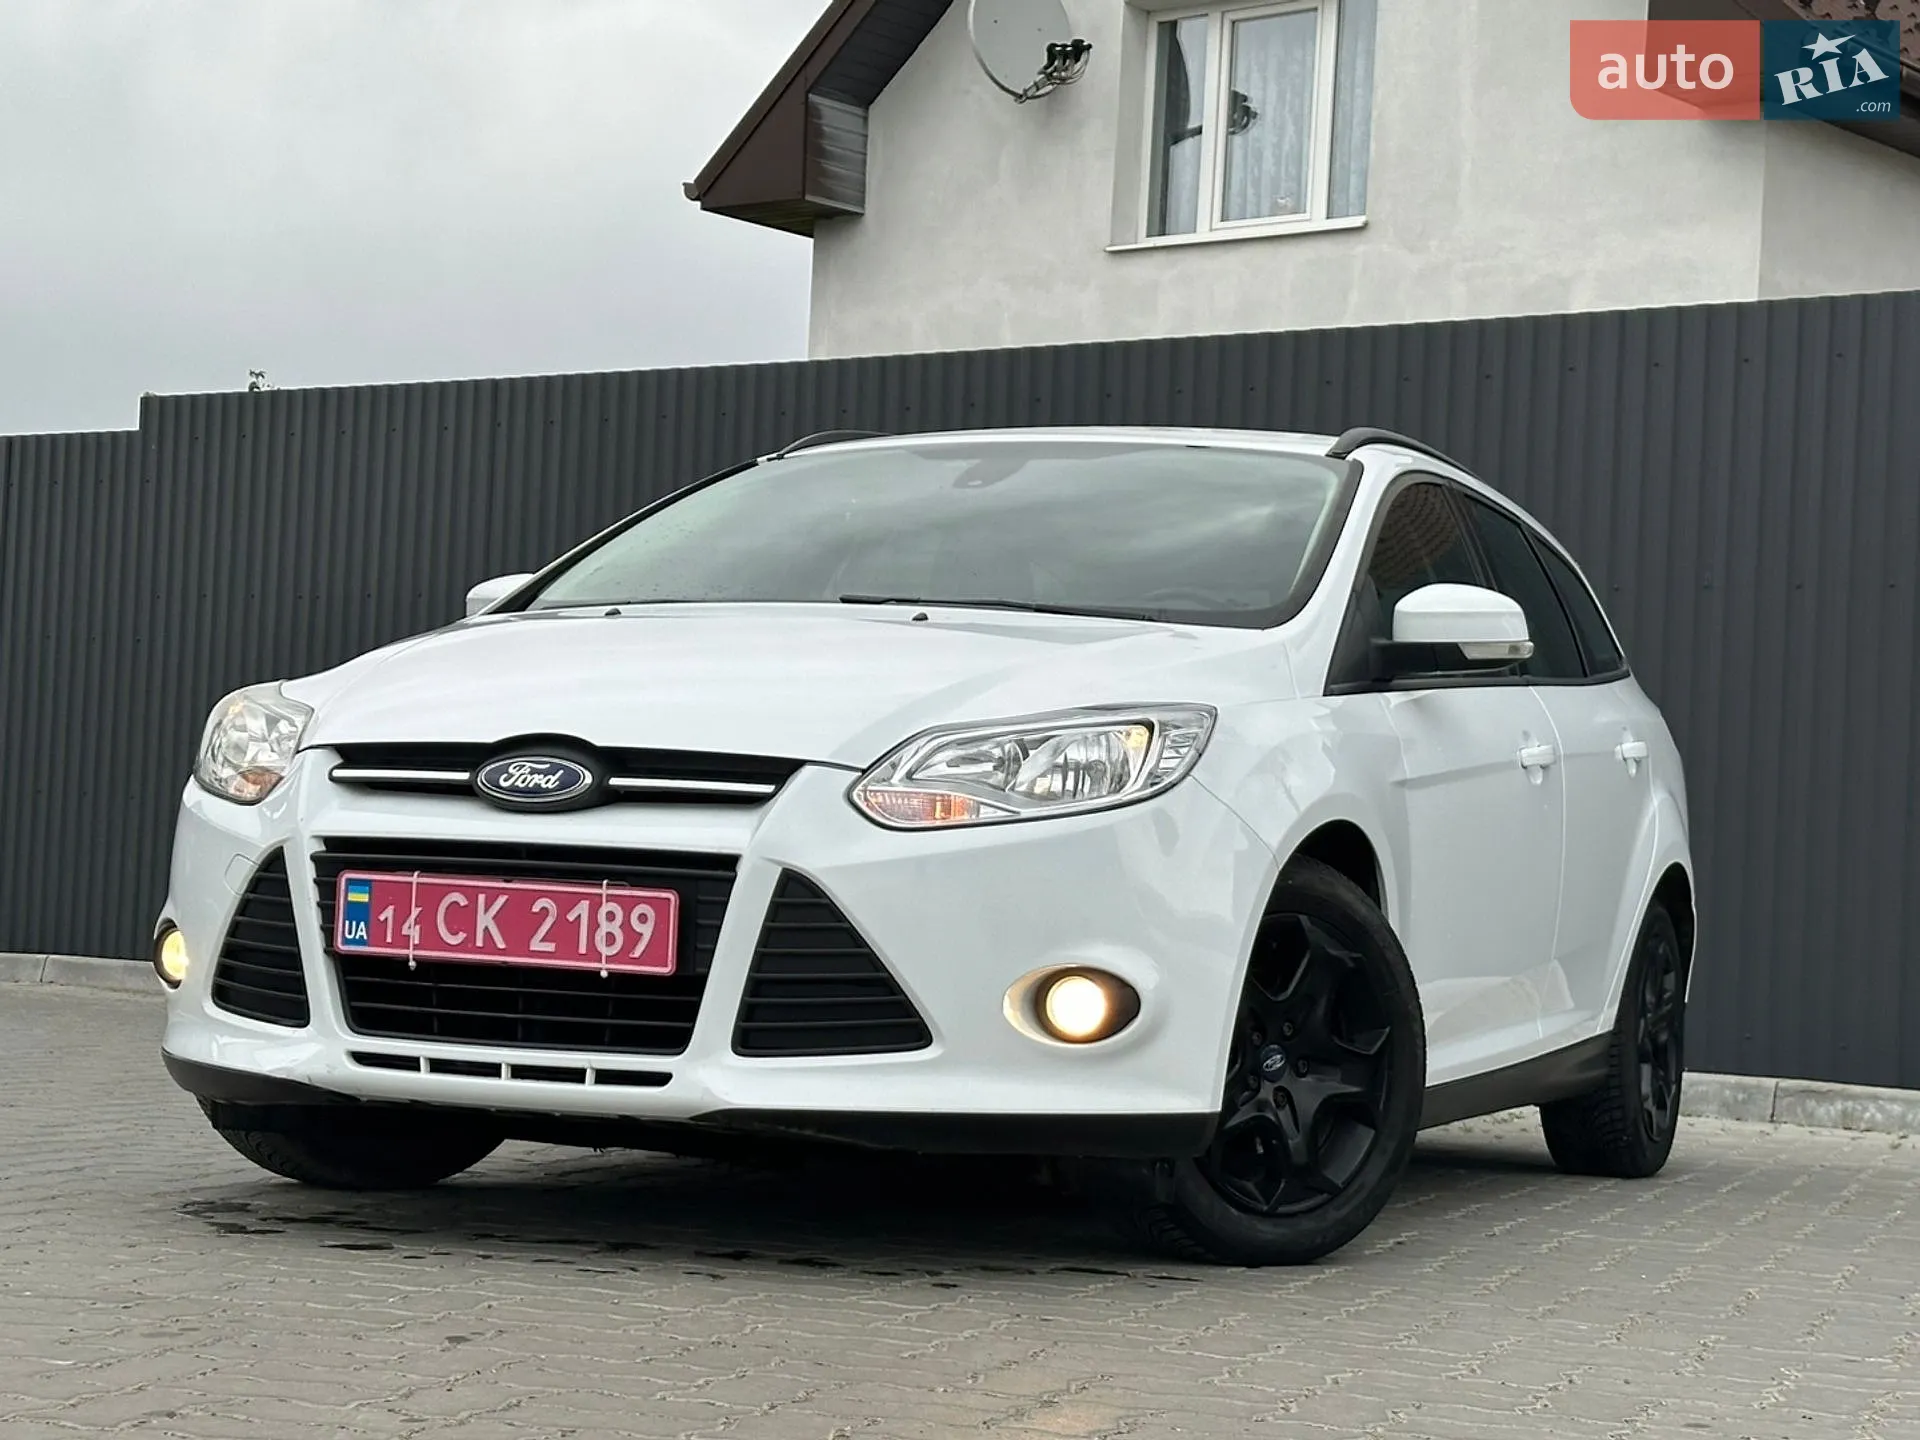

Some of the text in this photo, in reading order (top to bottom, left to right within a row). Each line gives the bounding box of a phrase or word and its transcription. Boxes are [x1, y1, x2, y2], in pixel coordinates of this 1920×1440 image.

[499, 761, 565, 789] Ford
[344, 920, 368, 941] UA
[377, 891, 656, 960] 14 CK 2189
